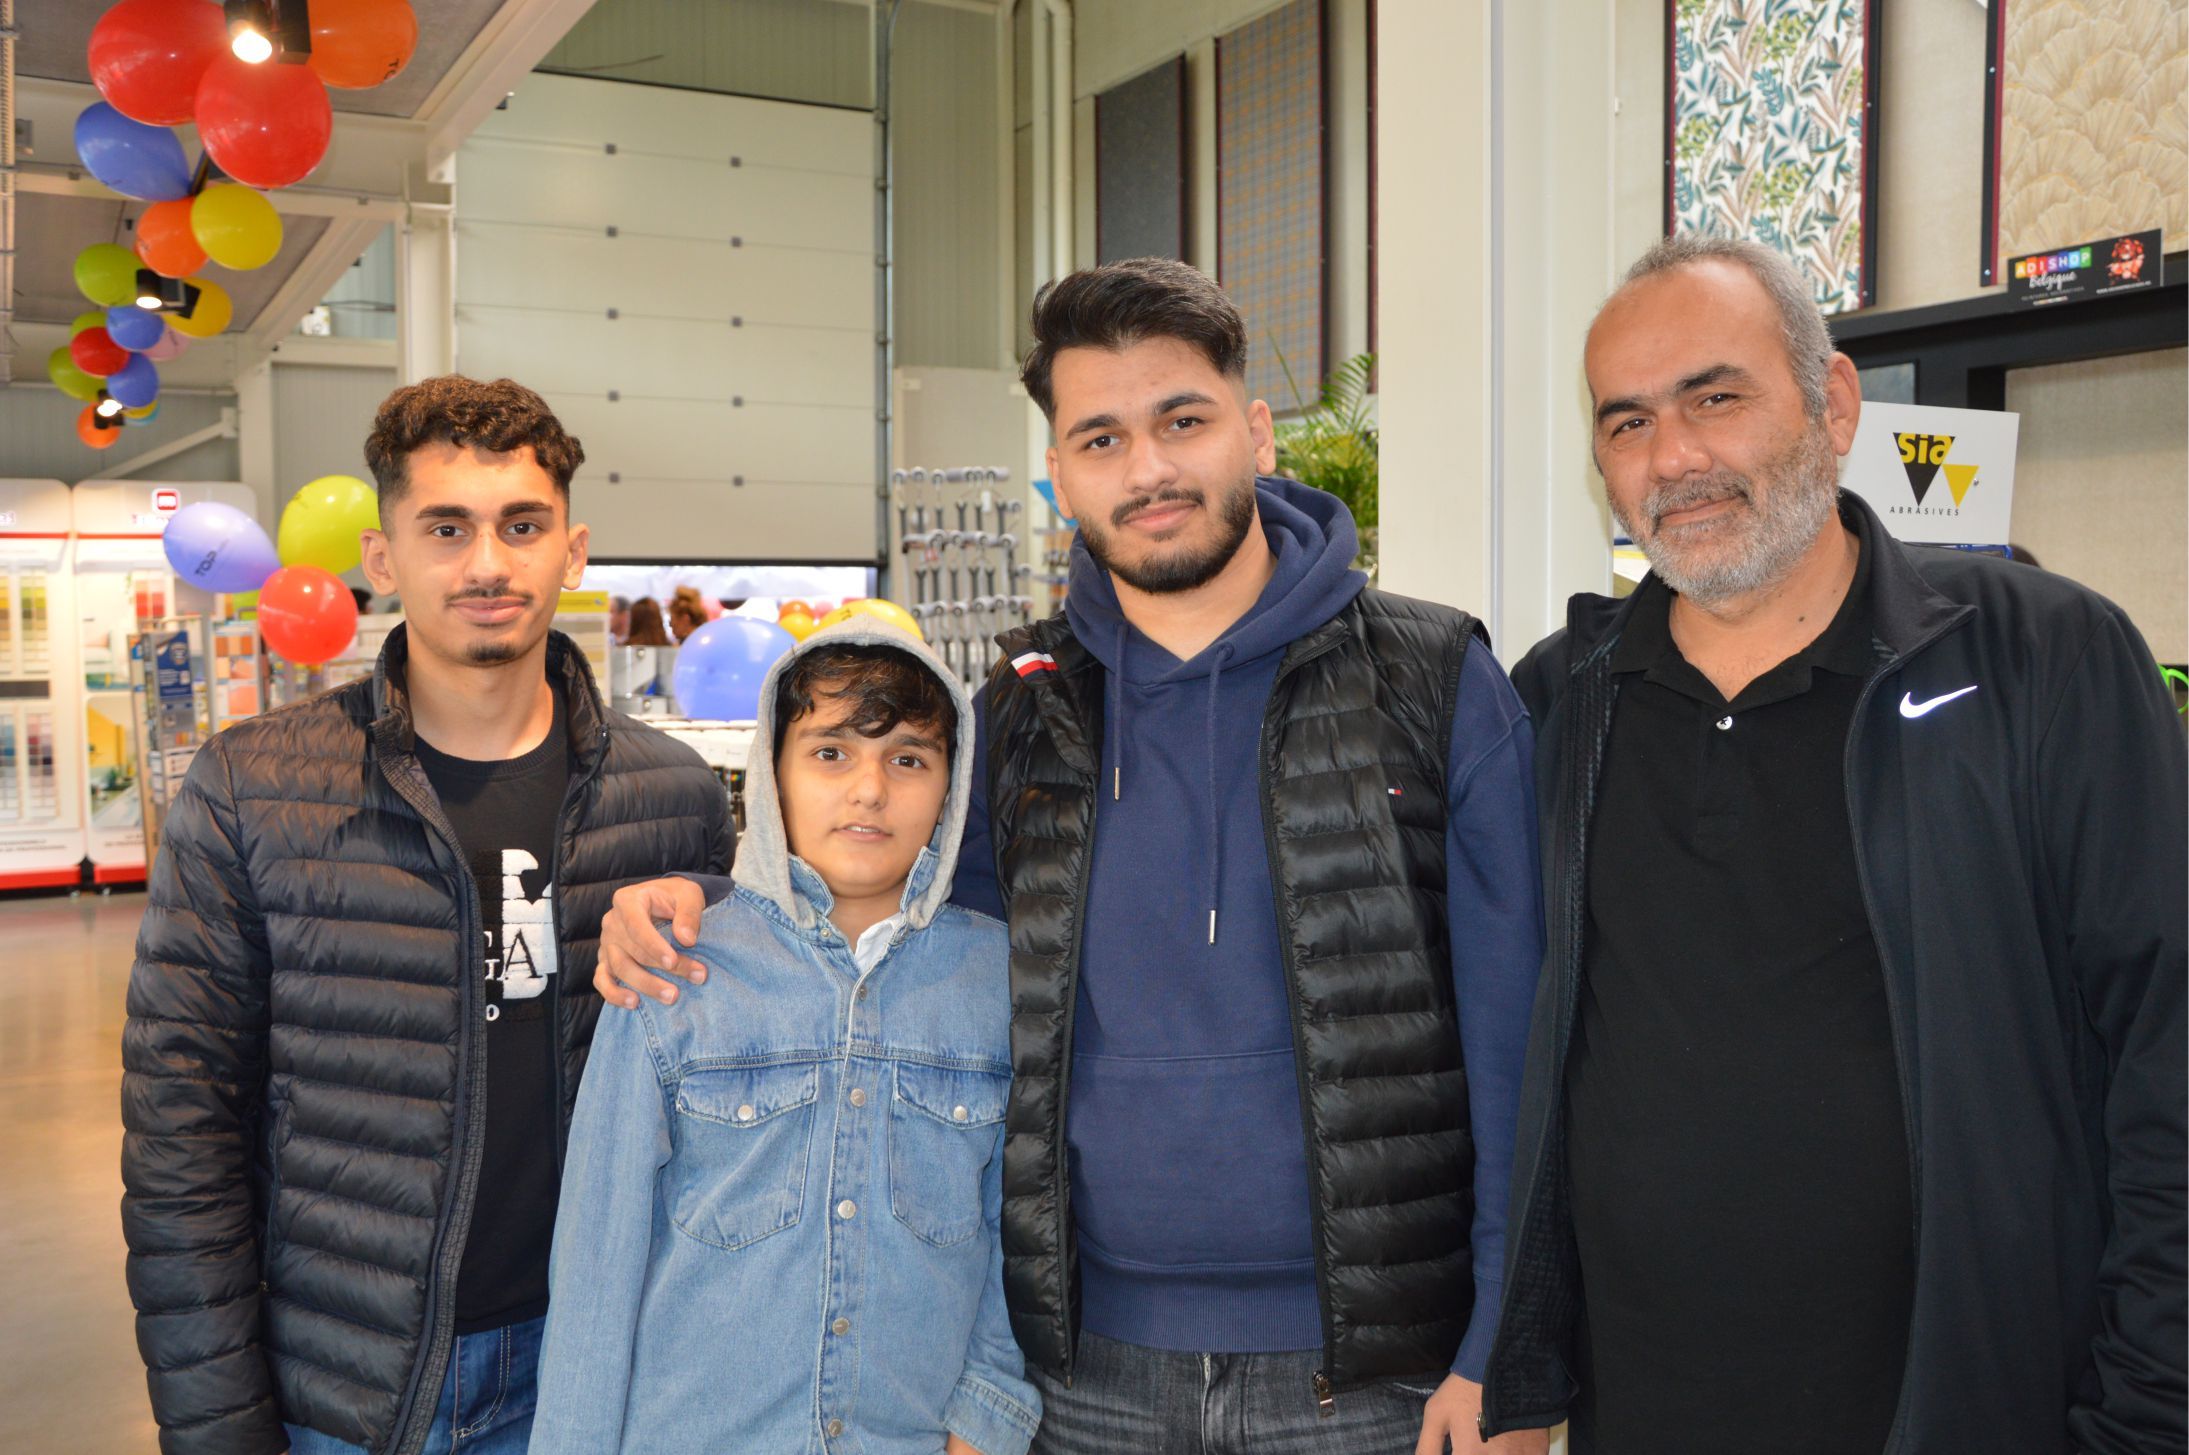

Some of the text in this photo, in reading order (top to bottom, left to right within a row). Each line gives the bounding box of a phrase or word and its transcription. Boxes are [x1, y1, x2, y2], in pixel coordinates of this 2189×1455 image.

[2015, 249, 2091, 276] ADISHOP
[2029, 271, 2077, 291] Belgique
[1889, 506, 1959, 516] ABRASIVES
[194, 550, 217, 577] TOP
